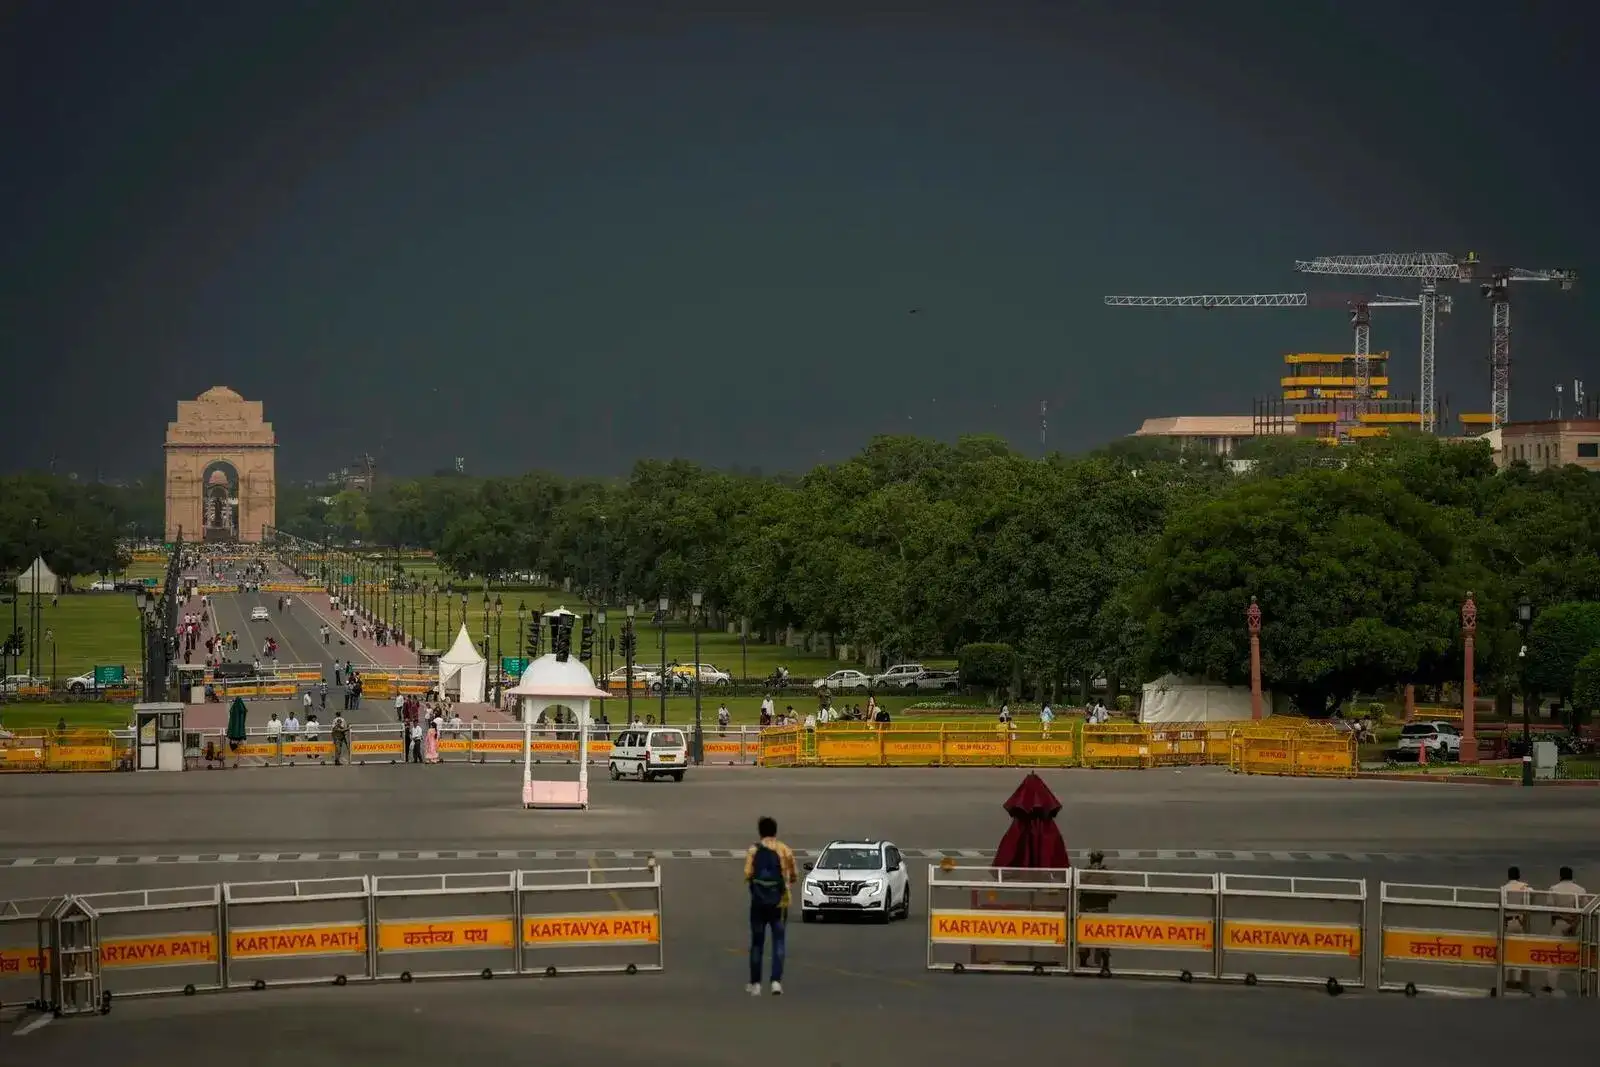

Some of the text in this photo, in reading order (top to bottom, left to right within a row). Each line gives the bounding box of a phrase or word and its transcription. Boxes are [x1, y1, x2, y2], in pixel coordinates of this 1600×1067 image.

[464, 929, 488, 943] पथ
[530, 920, 652, 937] KARTAVYA PATH
[939, 919, 1059, 936] KARTAVYA PATH
[1084, 923, 1206, 941] KARTAVYA PATH
[236, 931, 359, 952] KARTAVYA PATH
[1230, 929, 1354, 948] KARTAVYA PATH
[99, 940, 210, 961] ARTAVYA PATH
